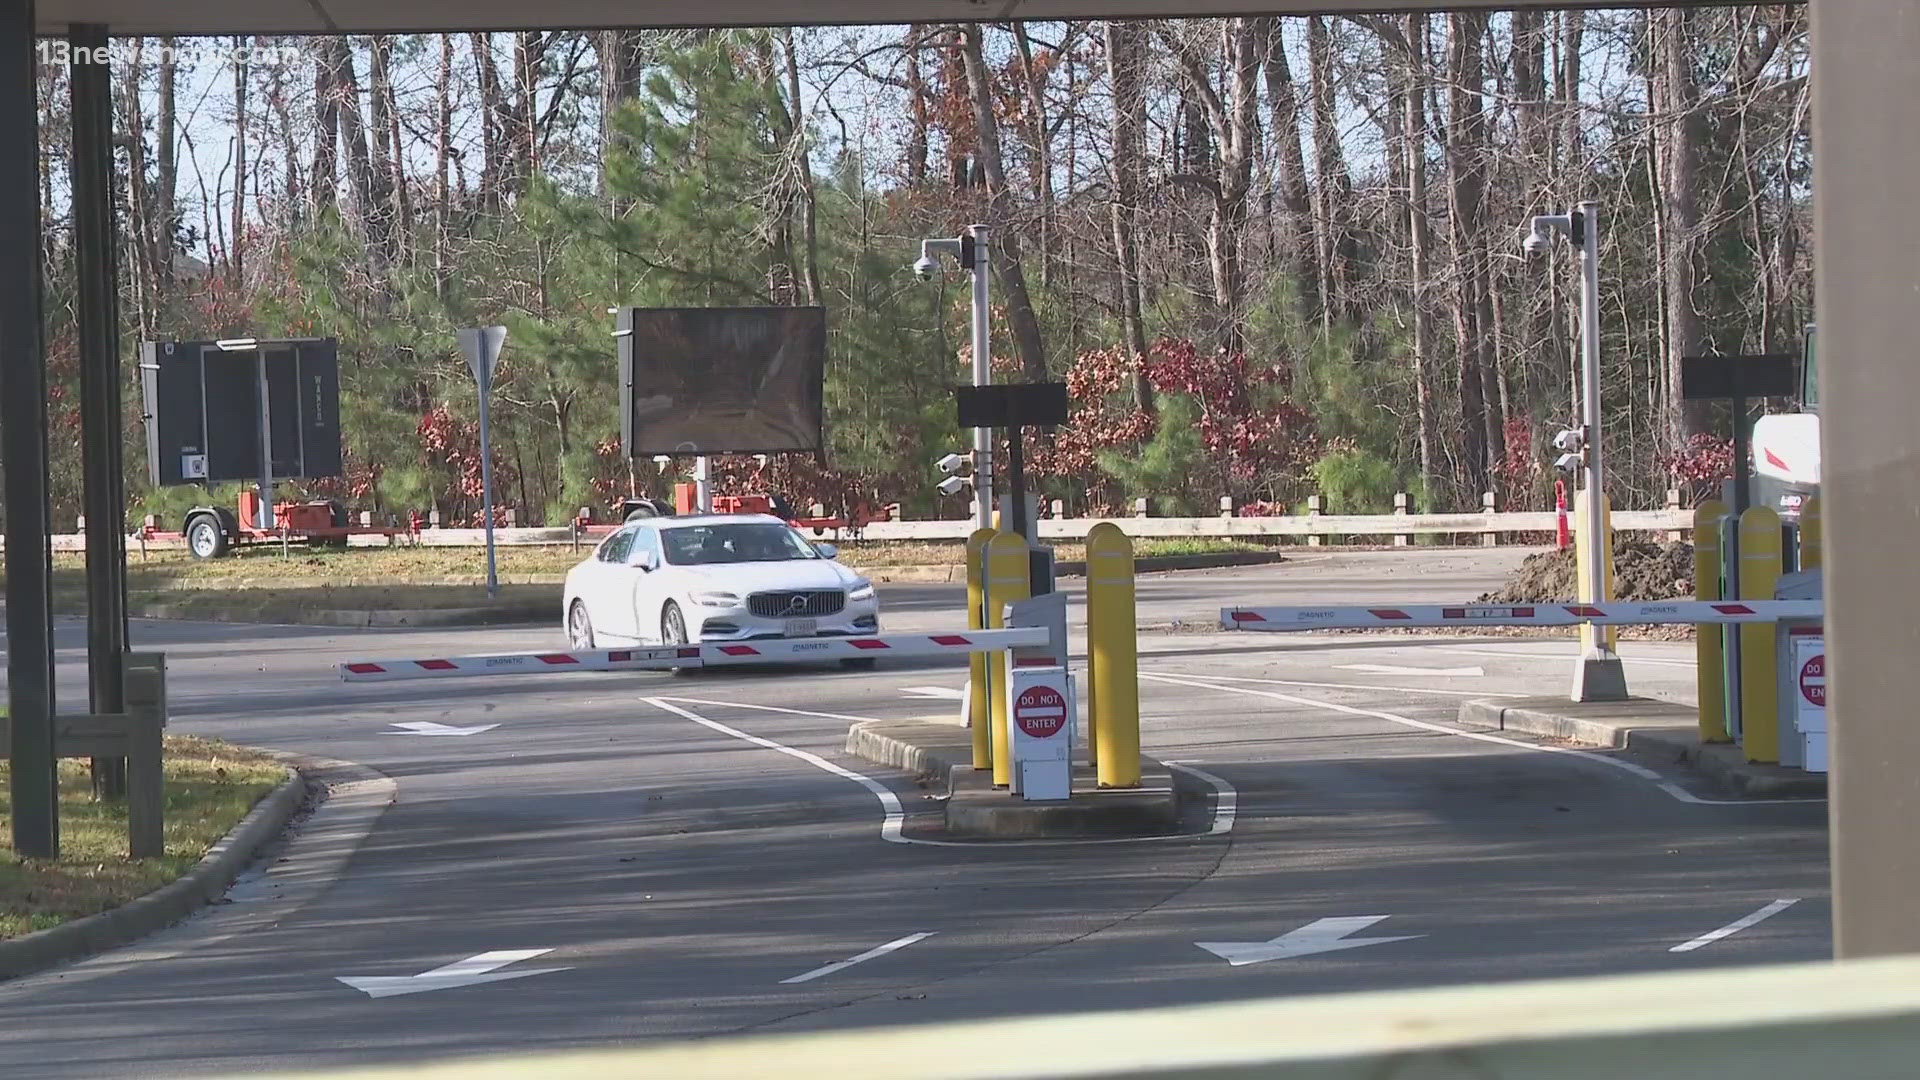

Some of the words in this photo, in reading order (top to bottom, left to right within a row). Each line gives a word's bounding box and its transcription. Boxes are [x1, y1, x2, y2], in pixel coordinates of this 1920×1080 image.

[1807, 664, 1821, 674] DO
[1021, 696, 1034, 706] DO
[1040, 695, 1059, 705] NOT
[1026, 718, 1057, 729] ENTER
